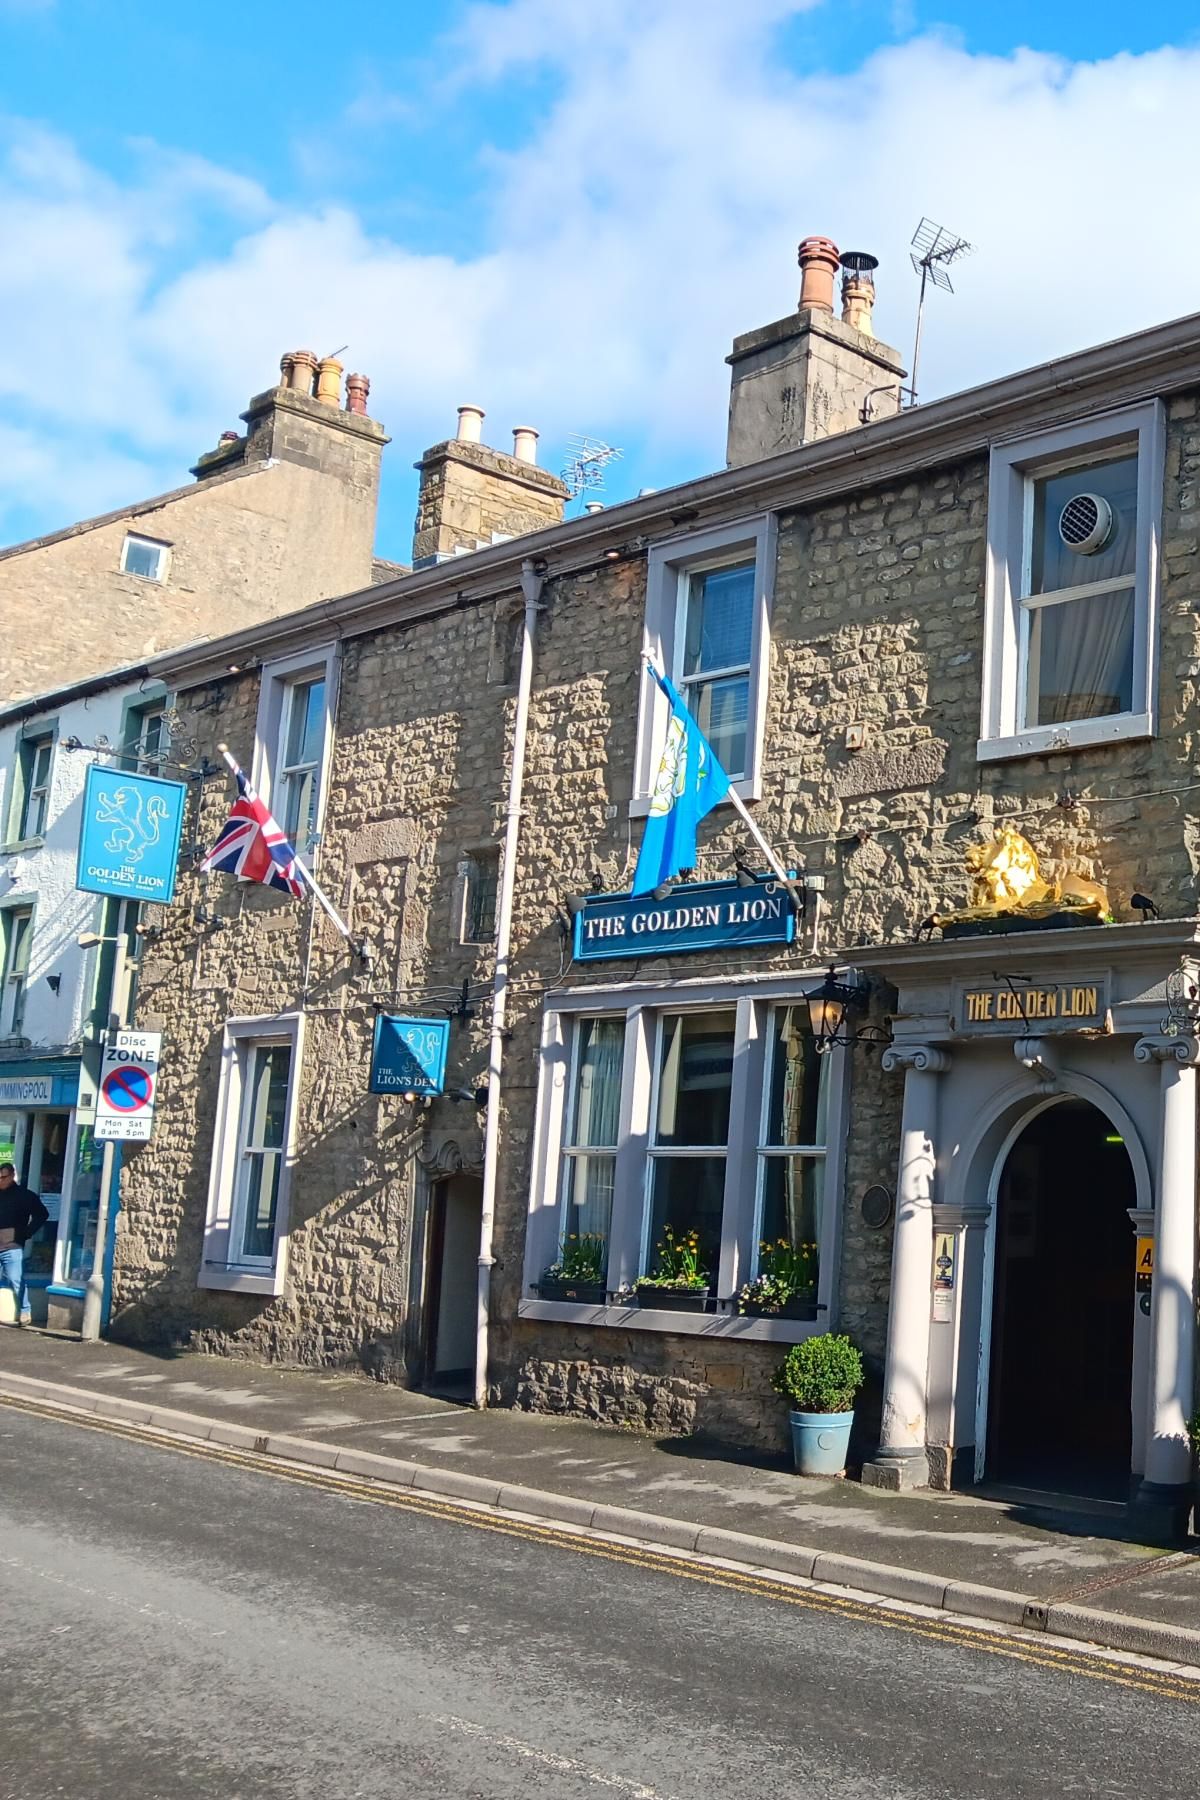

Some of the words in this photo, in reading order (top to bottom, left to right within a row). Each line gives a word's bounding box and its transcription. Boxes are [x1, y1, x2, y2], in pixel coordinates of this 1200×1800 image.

[120, 865, 136, 873] THE
[87, 866, 136, 882] GOLDEN
[137, 875, 165, 887] LION
[584, 914, 626, 939] THE
[631, 905, 720, 935] GOLDEN
[727, 898, 783, 924] LION
[966, 993, 993, 1021] THE
[1060, 986, 1098, 1016] LION
[120, 1036, 147, 1046] Disc
[106, 1048, 155, 1063] ZONE
[377, 1075, 412, 1086] LION'S
[414, 1078, 438, 1087] DEN
[104, 1119, 122, 1127] Mon
[128, 1120, 143, 1128] Sat
